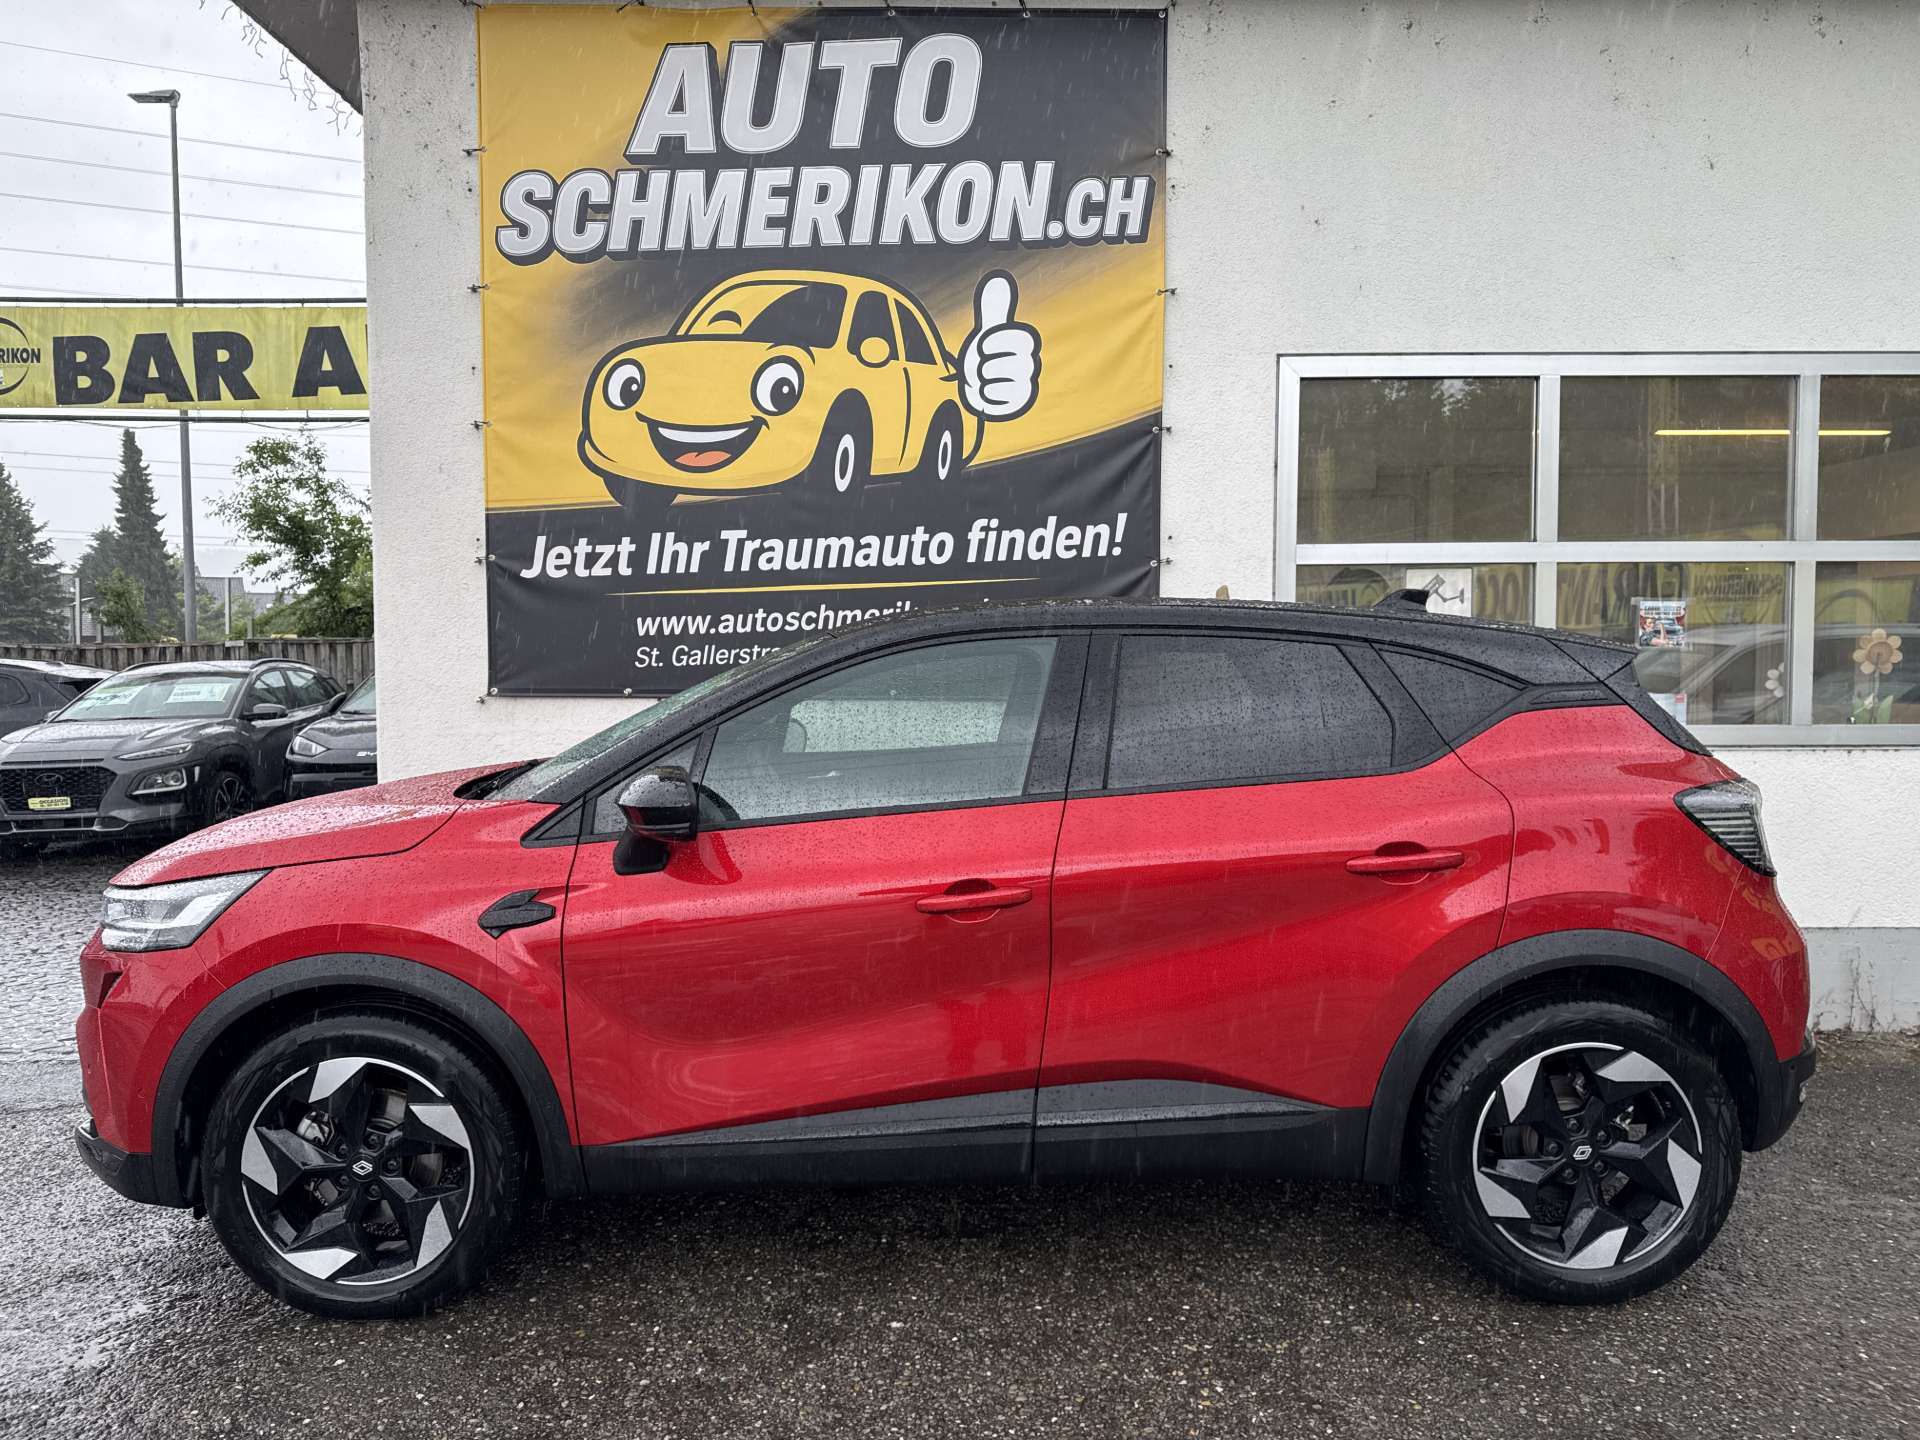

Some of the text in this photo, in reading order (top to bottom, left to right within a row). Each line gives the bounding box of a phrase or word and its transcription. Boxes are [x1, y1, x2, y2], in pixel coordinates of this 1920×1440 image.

[626, 32, 984, 157] AUTO
[498, 160, 1152, 258] SCHMERIKON.CH
[52, 325, 369, 405] BAR A
[519, 512, 1129, 579] Jetzt Ihr Traumauto finden!
[636, 600, 919, 637] www.autoschm
[634, 643, 781, 668] St. Gallerstr
